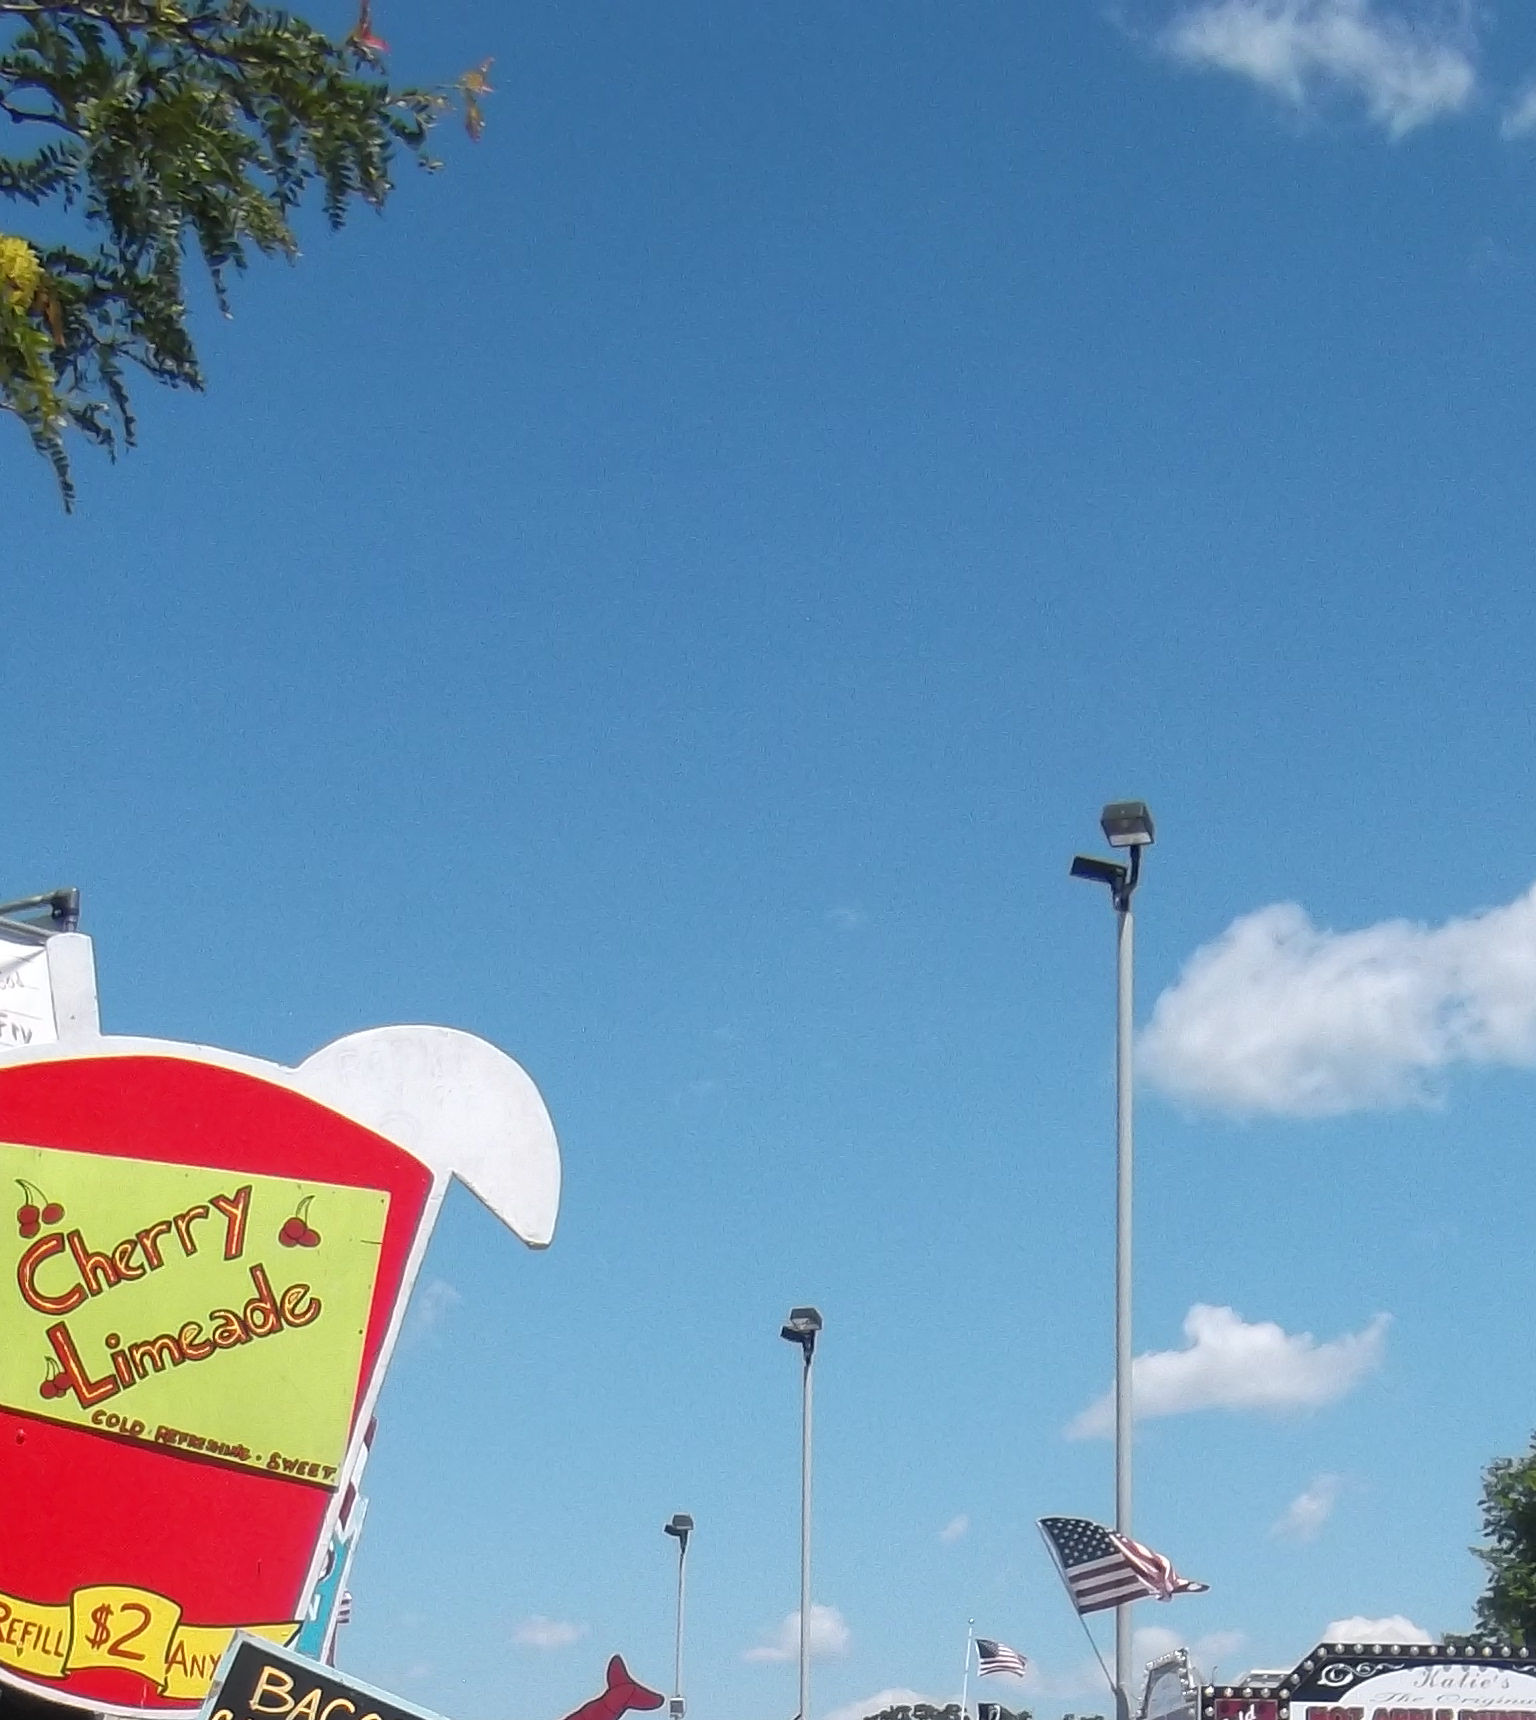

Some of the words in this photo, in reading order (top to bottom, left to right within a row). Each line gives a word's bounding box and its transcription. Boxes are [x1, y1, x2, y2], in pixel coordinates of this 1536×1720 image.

[17, 1185, 253, 1316] Cherry
[46, 1263, 321, 1410] Limeade
[91, 1409, 144, 1437] COLD
[266, 1451, 337, 1482] SWEET
[84, 1602, 152, 1661] $2
